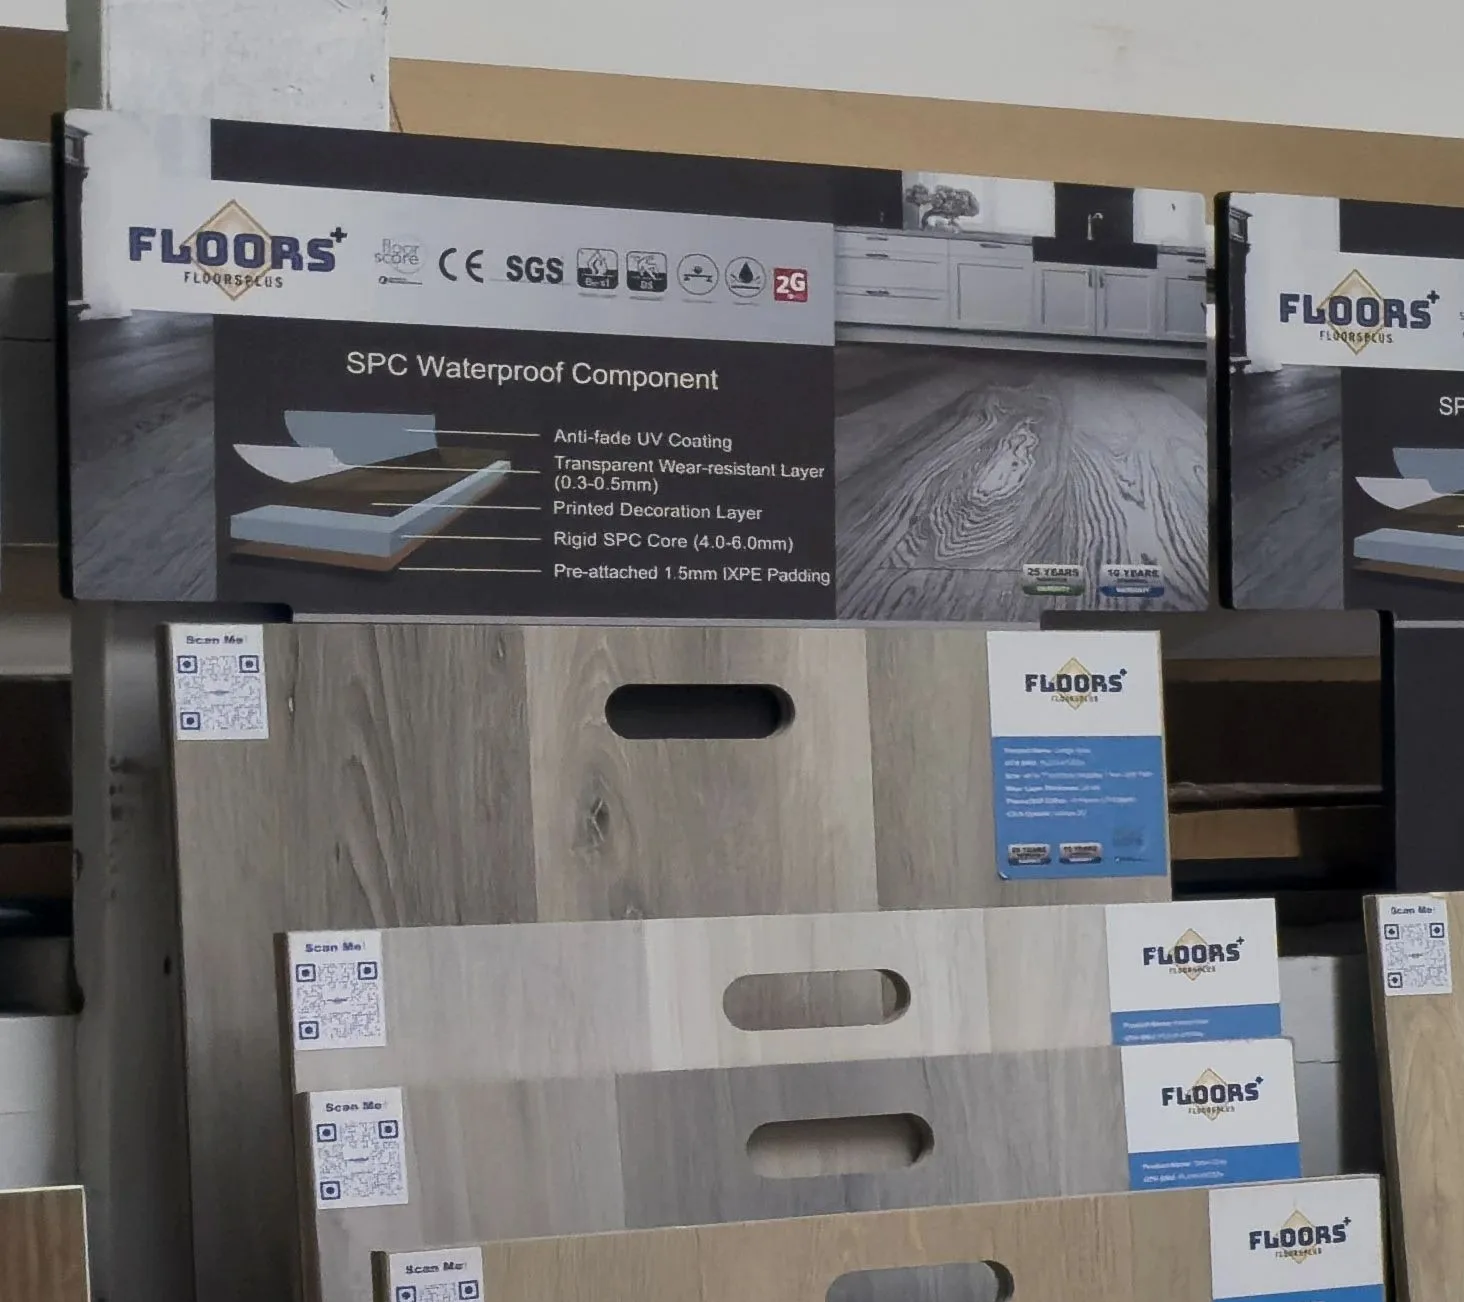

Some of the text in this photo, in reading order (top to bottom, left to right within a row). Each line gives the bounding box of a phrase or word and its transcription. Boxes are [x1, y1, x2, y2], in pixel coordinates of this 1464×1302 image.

[506, 255, 564, 285] SGS
[346, 352, 719, 391] SPC Waterproof Component
[554, 429, 733, 452] Anti-fade UV Coating
[554, 456, 825, 481] Transparent Wear-resistant Layer
[554, 475, 658, 494] (0.3-0.5mm)
[553, 500, 763, 522] Printed Decoration Layer
[553, 531, 794, 555] Rigid SPC Core (4.0-6.0mm)
[554, 564, 831, 587] Pre-attached 1.5mm IXPE Padding
[305, 943, 338, 952] Scan
